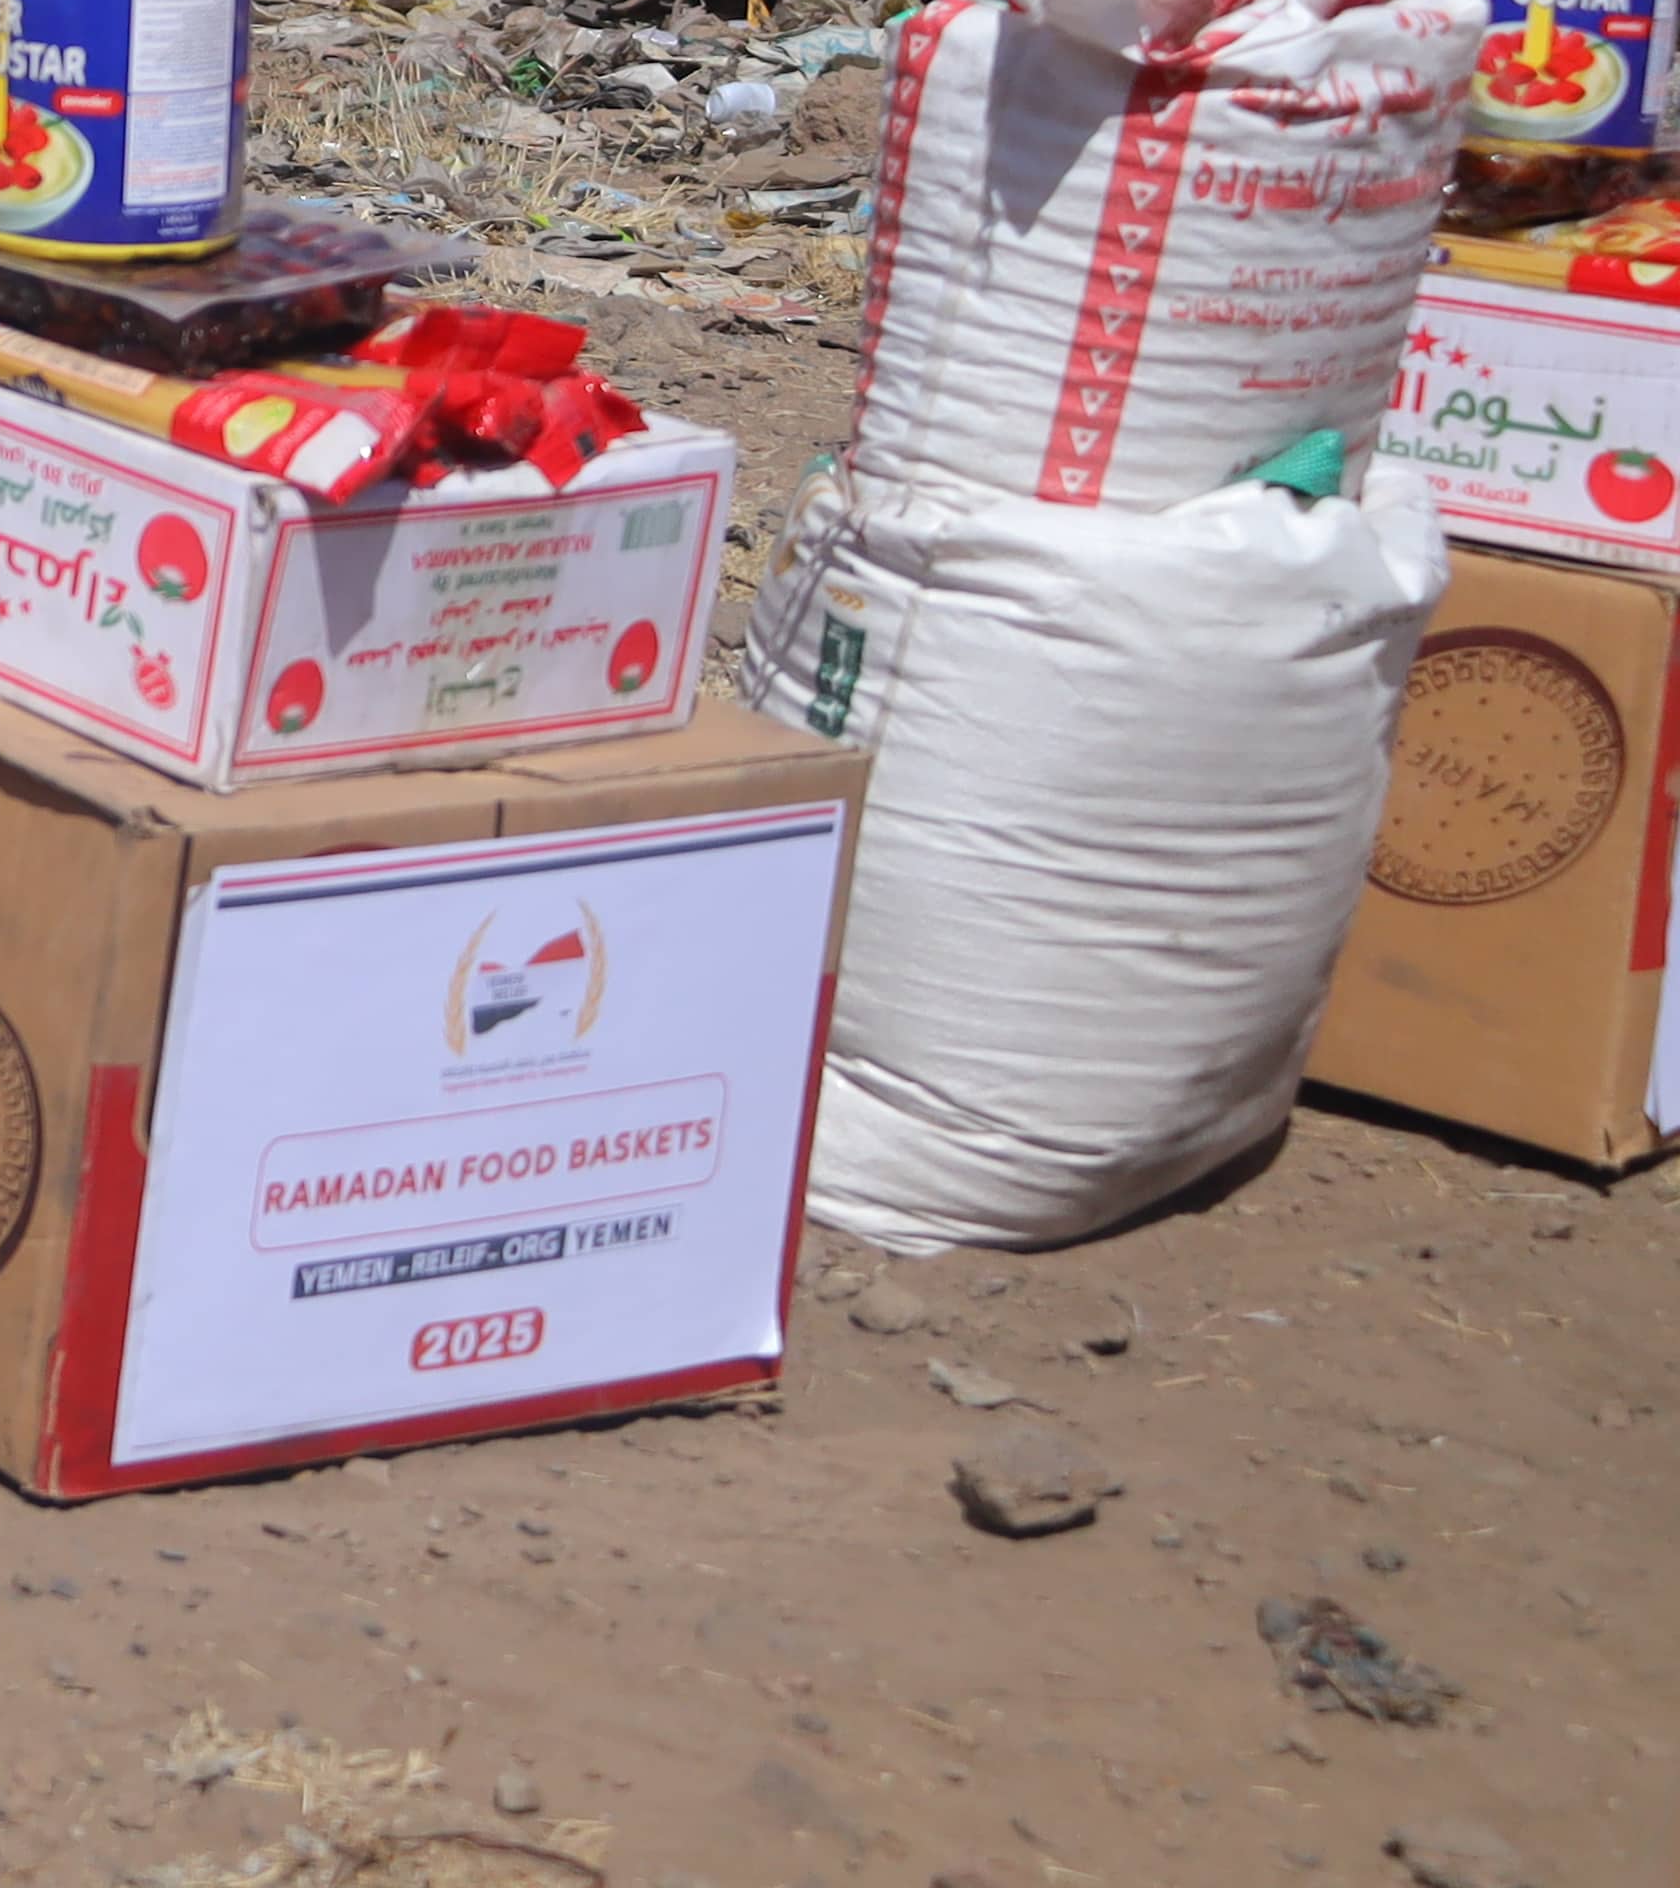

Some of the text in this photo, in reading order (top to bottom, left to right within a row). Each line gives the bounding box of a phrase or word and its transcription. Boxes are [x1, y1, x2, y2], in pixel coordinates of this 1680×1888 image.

[1431, 388, 1606, 443] نجوم
[263, 1118, 714, 1214] RAMADAN FOOD BASKETS
[298, 1258, 393, 1295] YEMEN
[501, 1231, 562, 1263] ORG
[574, 1211, 673, 1251] YEMEN
[417, 1311, 537, 1368] 2025
